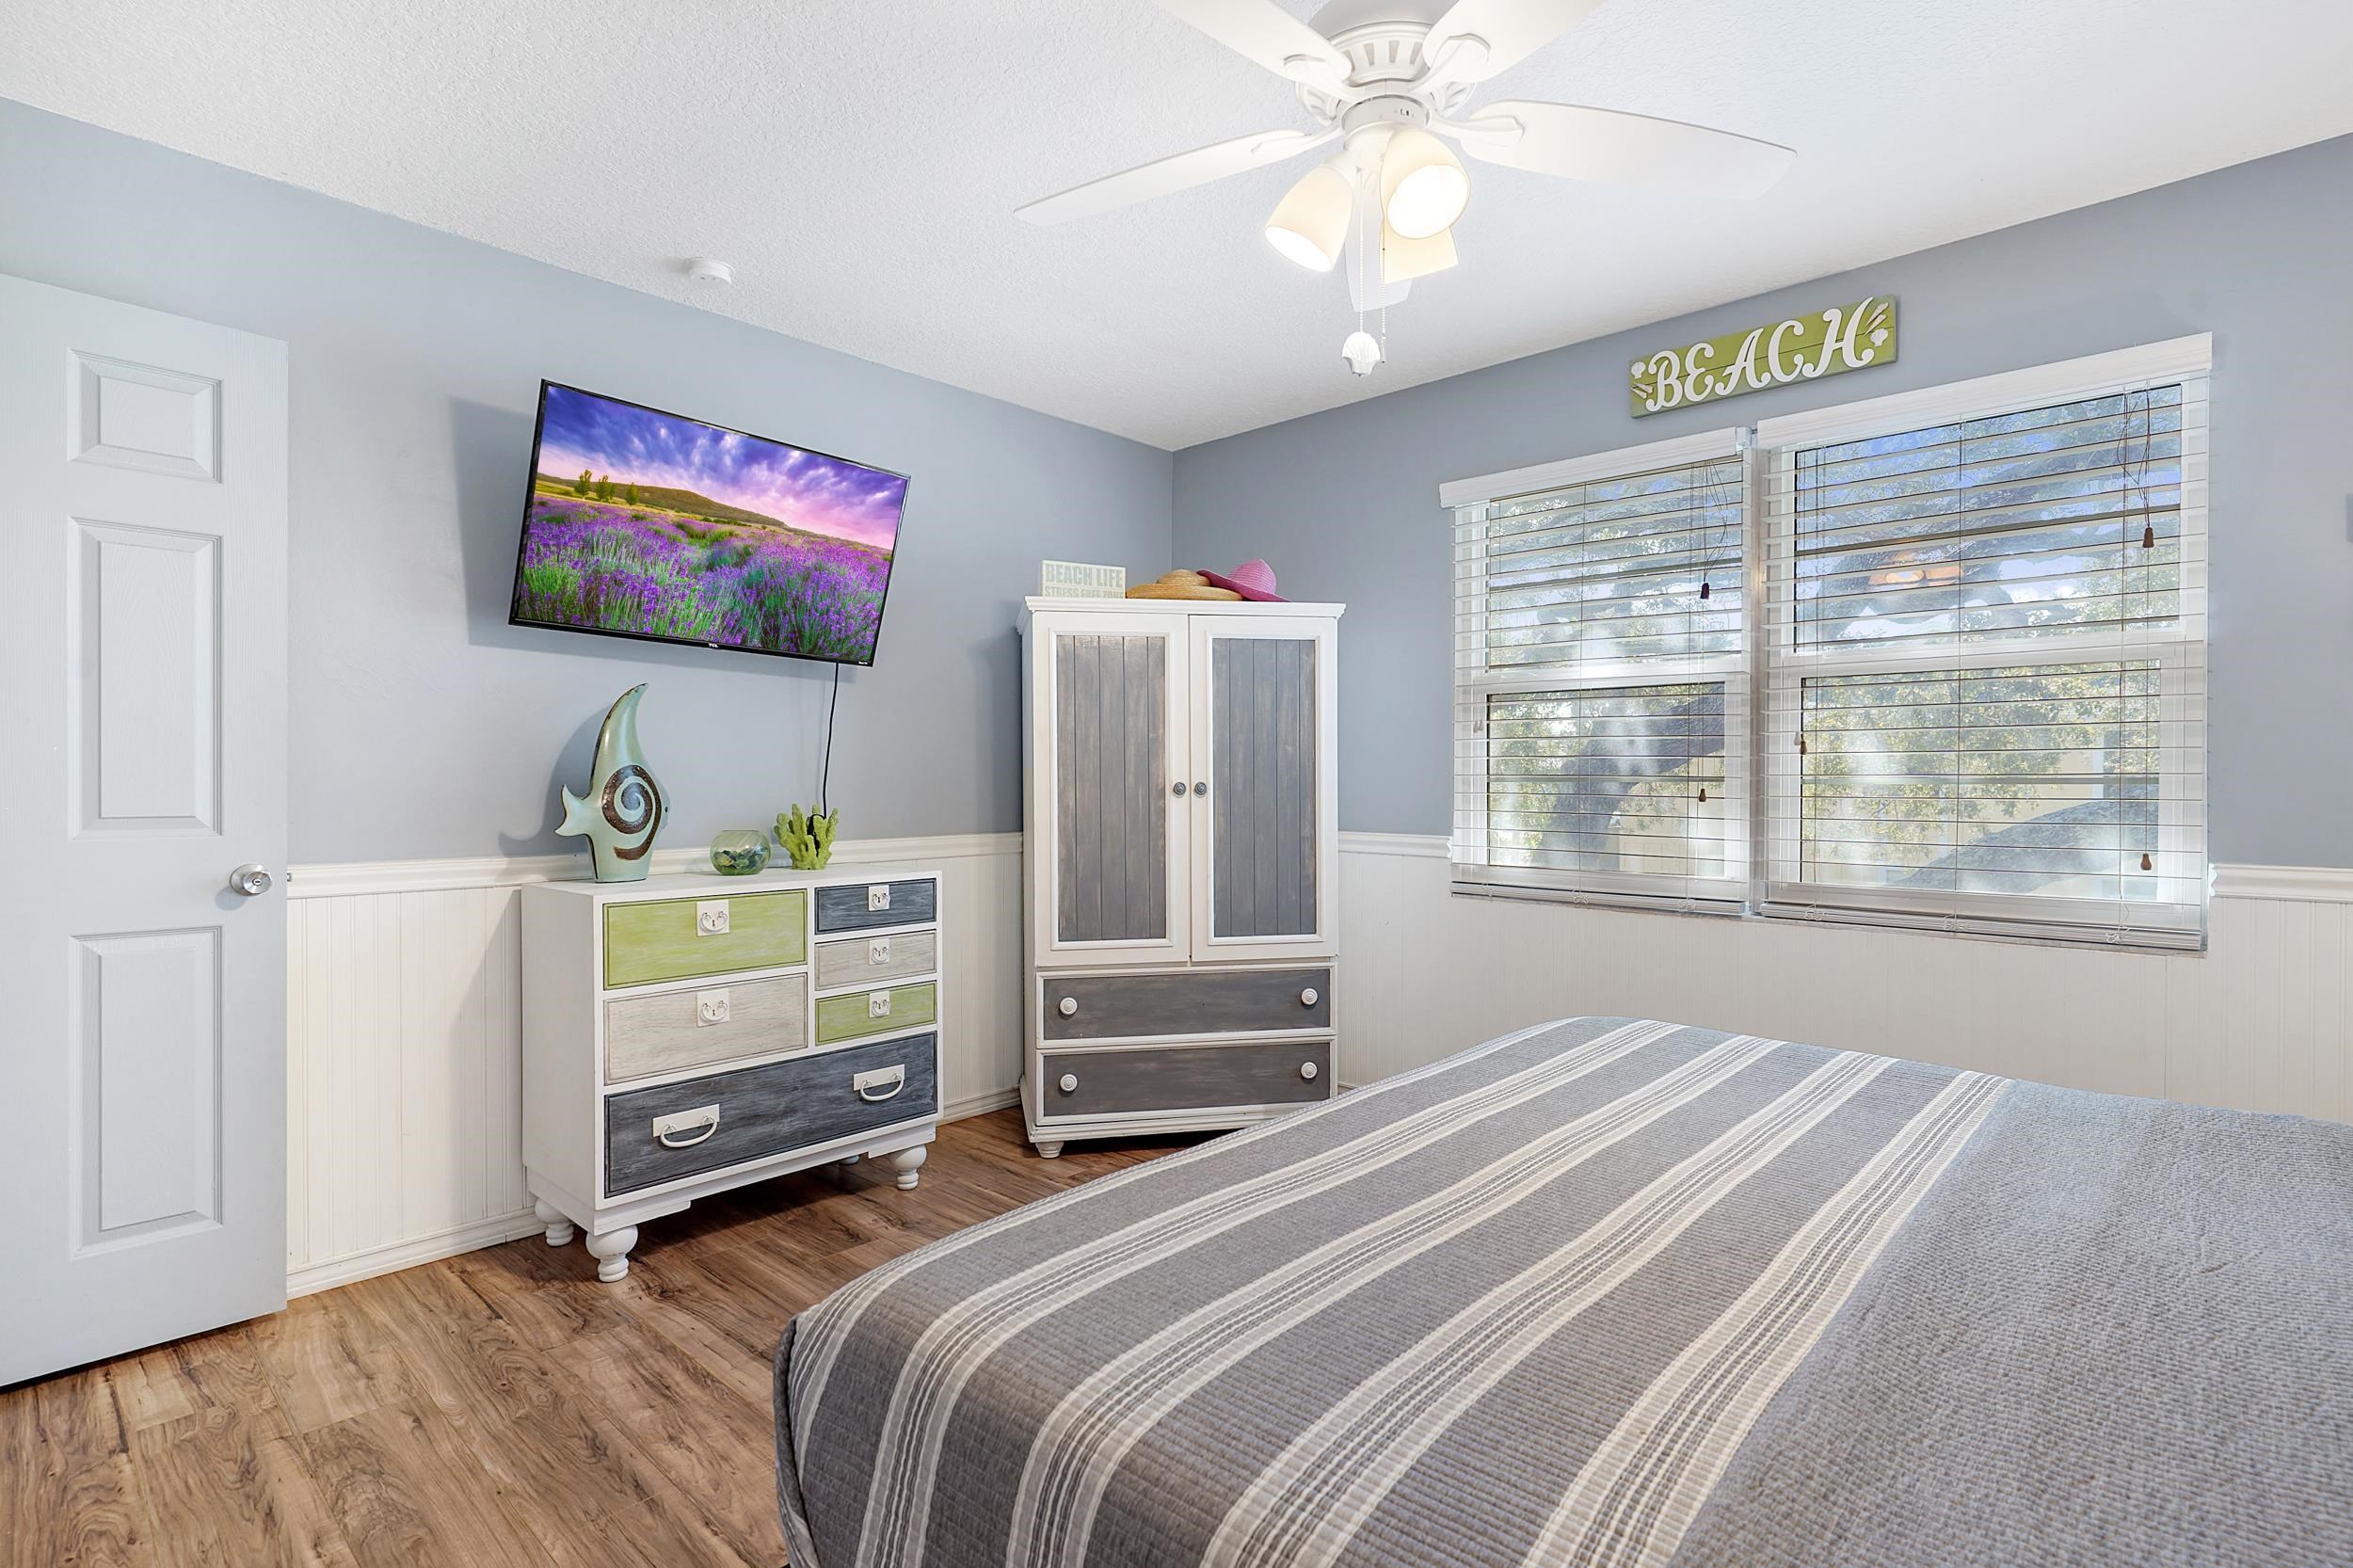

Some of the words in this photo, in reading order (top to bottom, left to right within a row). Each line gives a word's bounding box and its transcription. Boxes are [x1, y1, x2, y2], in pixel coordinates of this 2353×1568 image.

[1645, 296, 1875, 412] BEACH
[1045, 564, 1092, 585] BEACH
[1096, 568, 1123, 588] LIFE
[1045, 585, 1079, 598] STRESS
